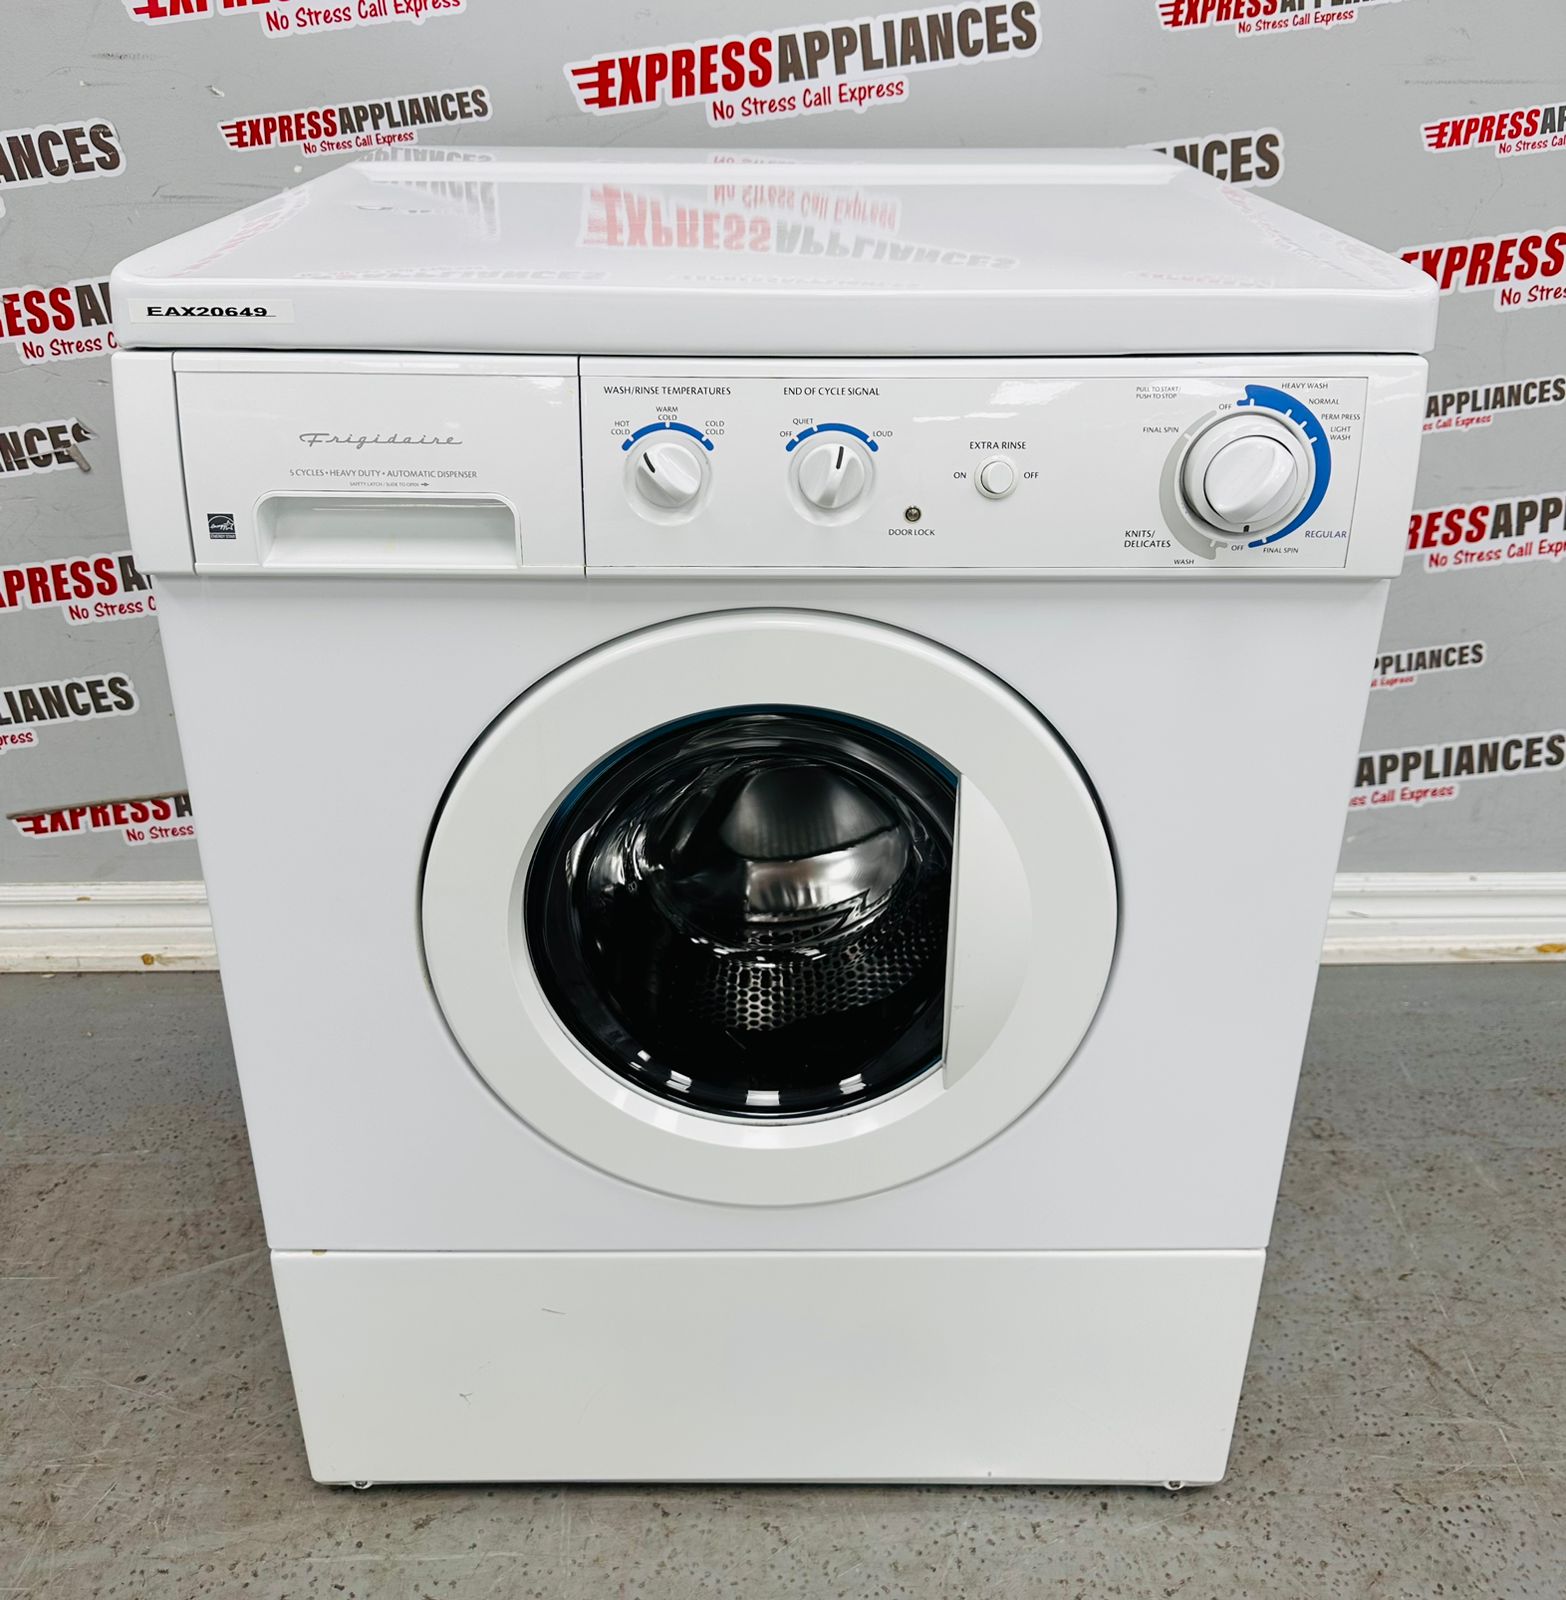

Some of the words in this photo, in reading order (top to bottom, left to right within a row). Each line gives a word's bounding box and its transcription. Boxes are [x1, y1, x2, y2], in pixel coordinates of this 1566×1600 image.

[267, 11, 289, 32] No
[297, 7, 351, 28] Stress
[358, 0, 388, 19] Call
[1239, 21, 1252, 33] No
[1255, 19, 1288, 31] Stress
[1293, 14, 1310, 26] Call
[1314, 10, 1354, 25] Express
[712, 100, 734, 121] No
[742, 94, 796, 118] Stress
[803, 87, 831, 107] Call
[839, 78, 904, 105] Express
[304, 142, 317, 154] No
[320, 139, 353, 152] Stress
[355, 134, 373, 148] Call
[376, 131, 414, 148] Express
[1499, 143, 1511, 154] No
[1515, 140, 1548, 152] Stress
[1501, 287, 1521, 306] No
[1528, 285, 1566, 303] Stre
[146, 306, 268, 317] EAX20649
[22, 341, 44, 359] No
[49, 338, 102, 356] Stress
[603, 385, 660, 395] WASH/RINSE
[662, 385, 732, 396] TEMPERATURES
[783, 386, 803, 396] END
[804, 386, 817, 396] OF
[818, 386, 847, 396] CYCLE
[847, 386, 881, 396] SIGNAL
[1308, 398, 1340, 406] NORMAL
[1425, 378, 1566, 418] APPLIANCES
[655, 405, 679, 413] WARM
[1218, 403, 1232, 411] OFF
[657, 413, 678, 421] COLD
[792, 417, 814, 426] QUIET
[1321, 413, 1341, 421] PERM
[1341, 413, 1361, 421] PRESS
[614, 420, 630, 428] HOT
[704, 420, 725, 428] COLD
[610, 428, 631, 436] COLD
[704, 428, 725, 436] COLD
[779, 430, 793, 438] OFF
[872, 430, 894, 438] LOUD
[299, 432, 463, 450] Frigidaire
[1330, 433, 1352, 441] WASH
[969, 441, 999, 450] EXTRA
[1001, 441, 1027, 450] RINSE
[289, 469, 295, 477] 5
[295, 469, 325, 477] CYCLES
[329, 469, 356, 478] HEAVY
[358, 469, 381, 478] DUTY
[387, 469, 436, 479] AUTOMATIC
[437, 470, 478, 479] DISPENSER
[953, 471, 967, 479] ON
[1023, 471, 1039, 479] OFF
[888, 528, 913, 536] DOOR
[913, 528, 936, 536] LOCK
[1124, 529, 1156, 539] KNITS/
[1304, 530, 1348, 539] REGULAR
[1123, 539, 1172, 548] DELICATES
[1230, 544, 1245, 552] OFF
[1428, 552, 1448, 568] No
[1453, 549, 1502, 566] Stress
[1506, 541, 1534, 559] Call
[68, 605, 89, 620] No
[94, 601, 144, 617] Stress
[1371, 790, 1395, 804] Call
[1400, 786, 1454, 803] Express
[126, 828, 145, 842] No
[149, 825, 195, 839] Stress
